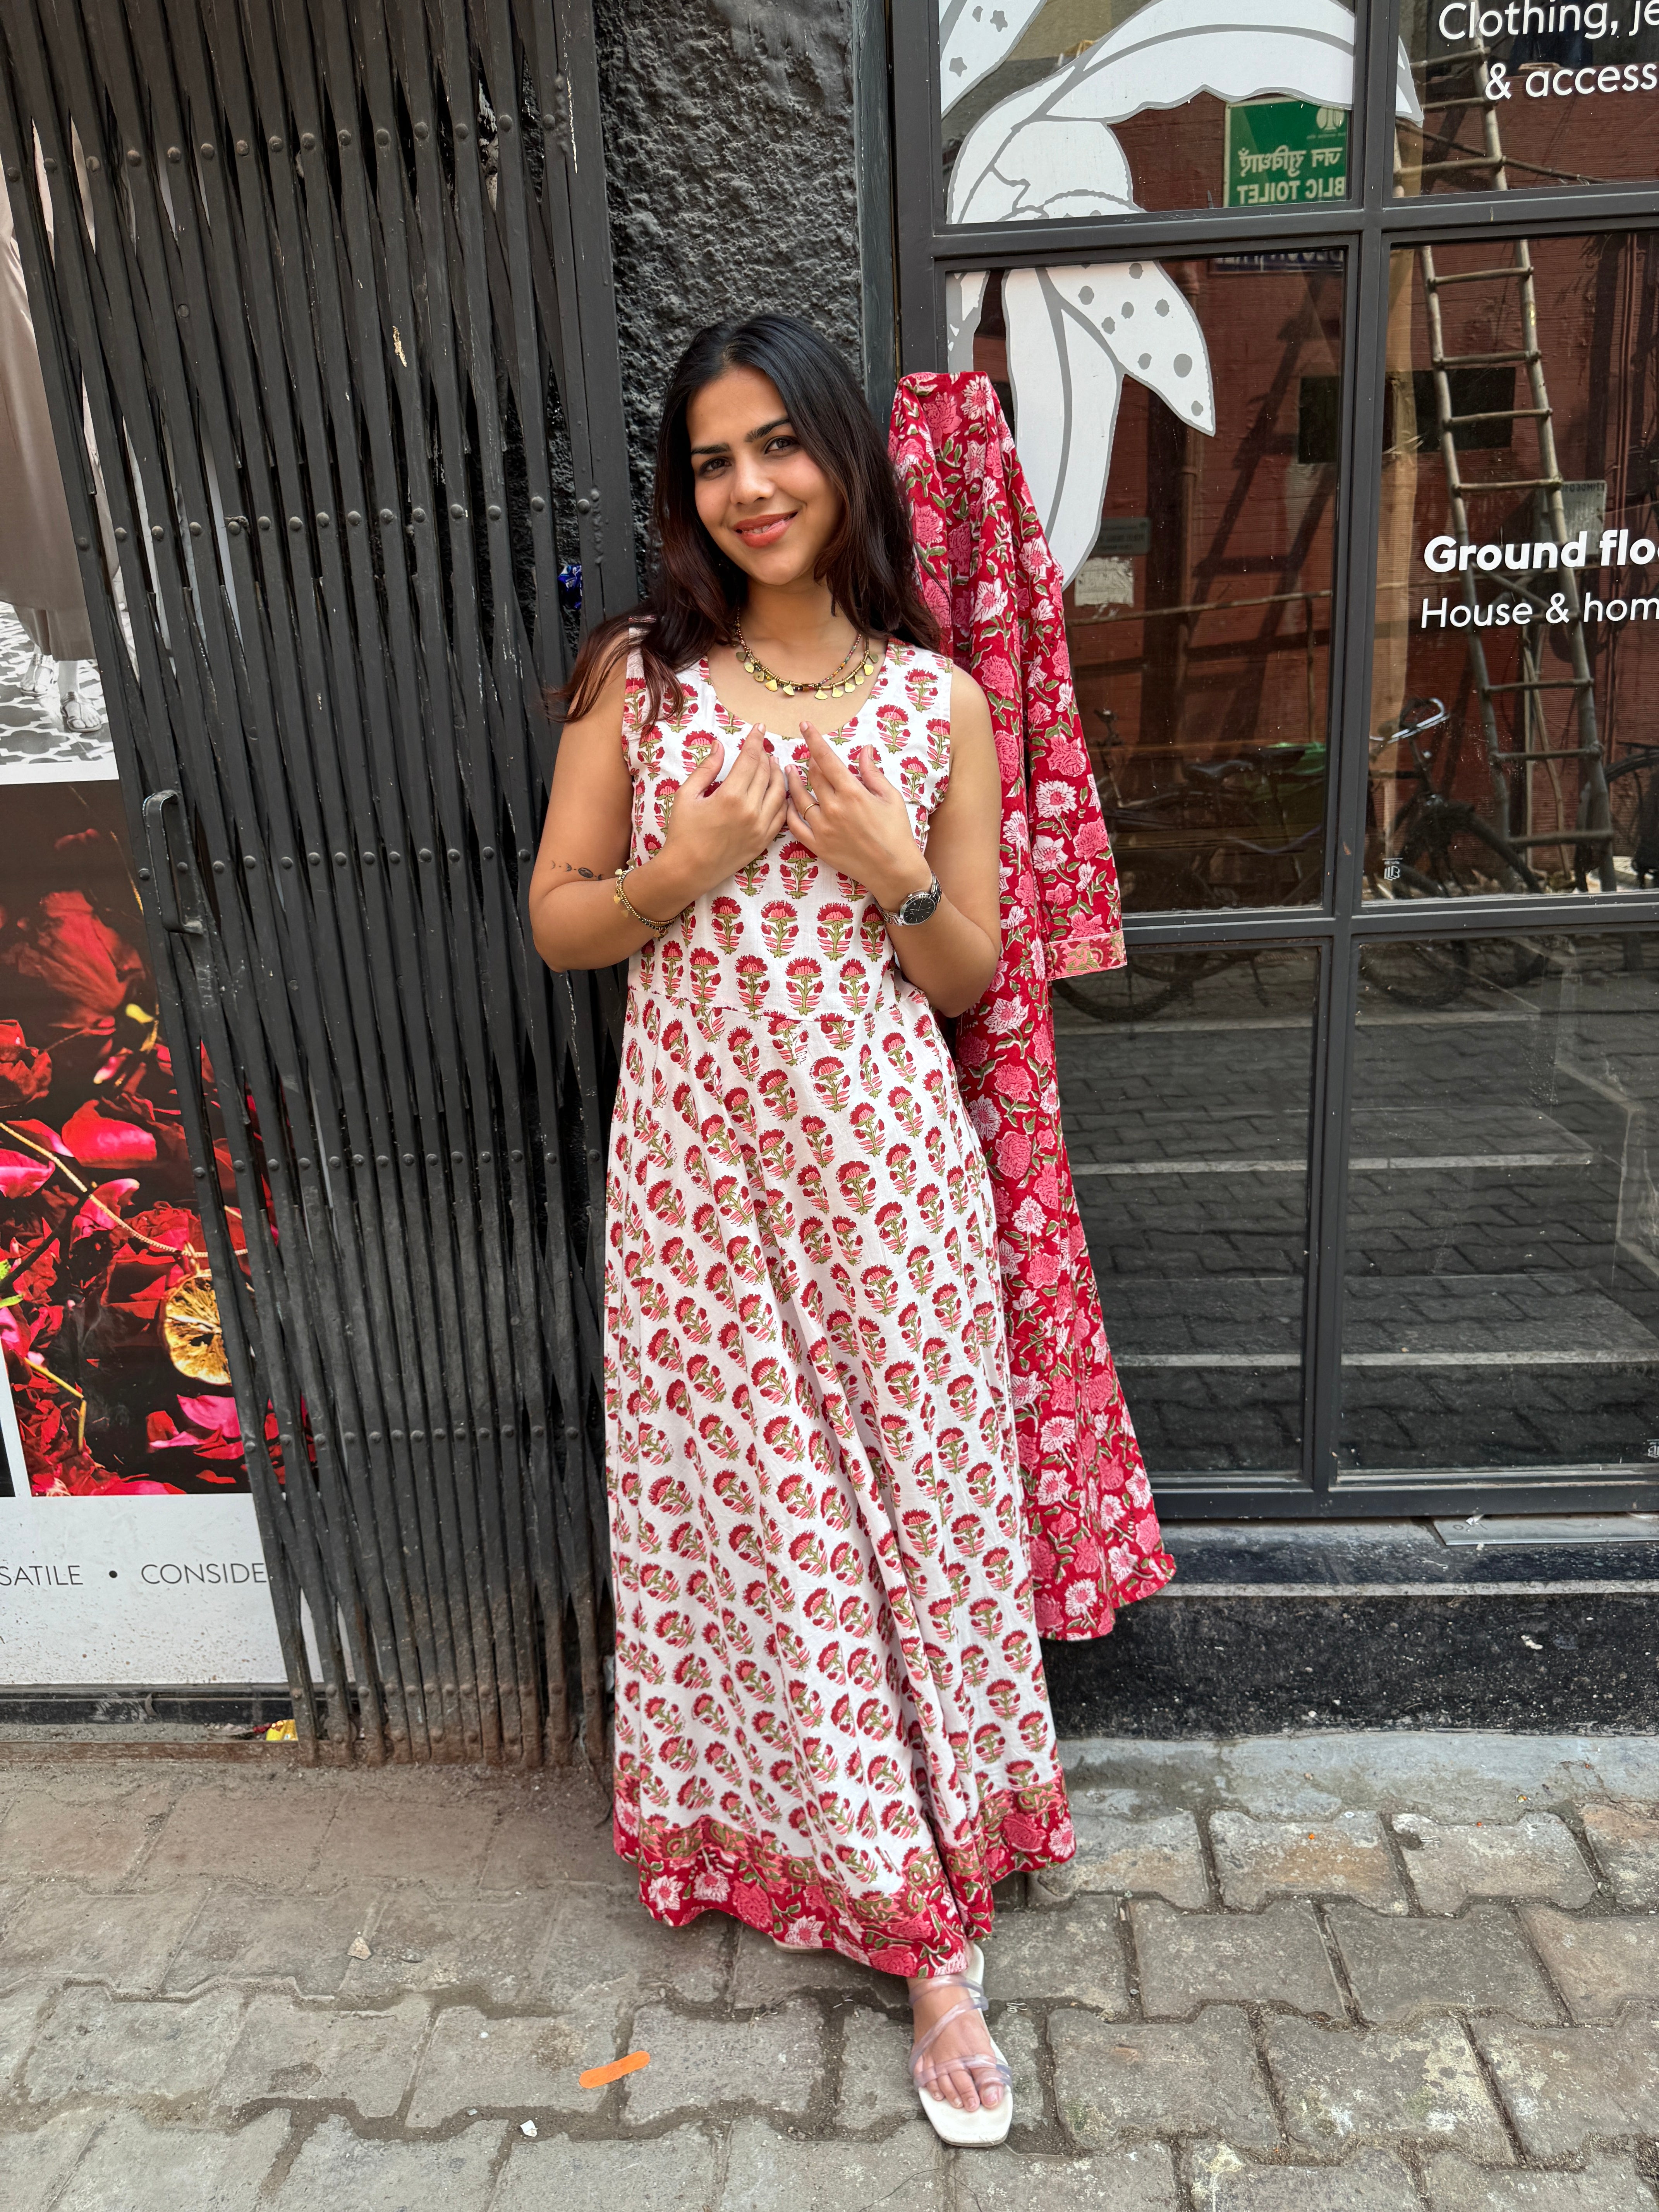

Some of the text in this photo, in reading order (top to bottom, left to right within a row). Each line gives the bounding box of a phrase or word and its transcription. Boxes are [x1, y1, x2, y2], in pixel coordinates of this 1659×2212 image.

[1439, 0, 1618, 40] Clothing,
[1485, 63, 1657, 100] & access
[1424, 529, 1659, 573] Ground flo
[1421, 592, 1659, 629] House & hom
[0, 1563, 267, 1586] SATILE CONSIDE
